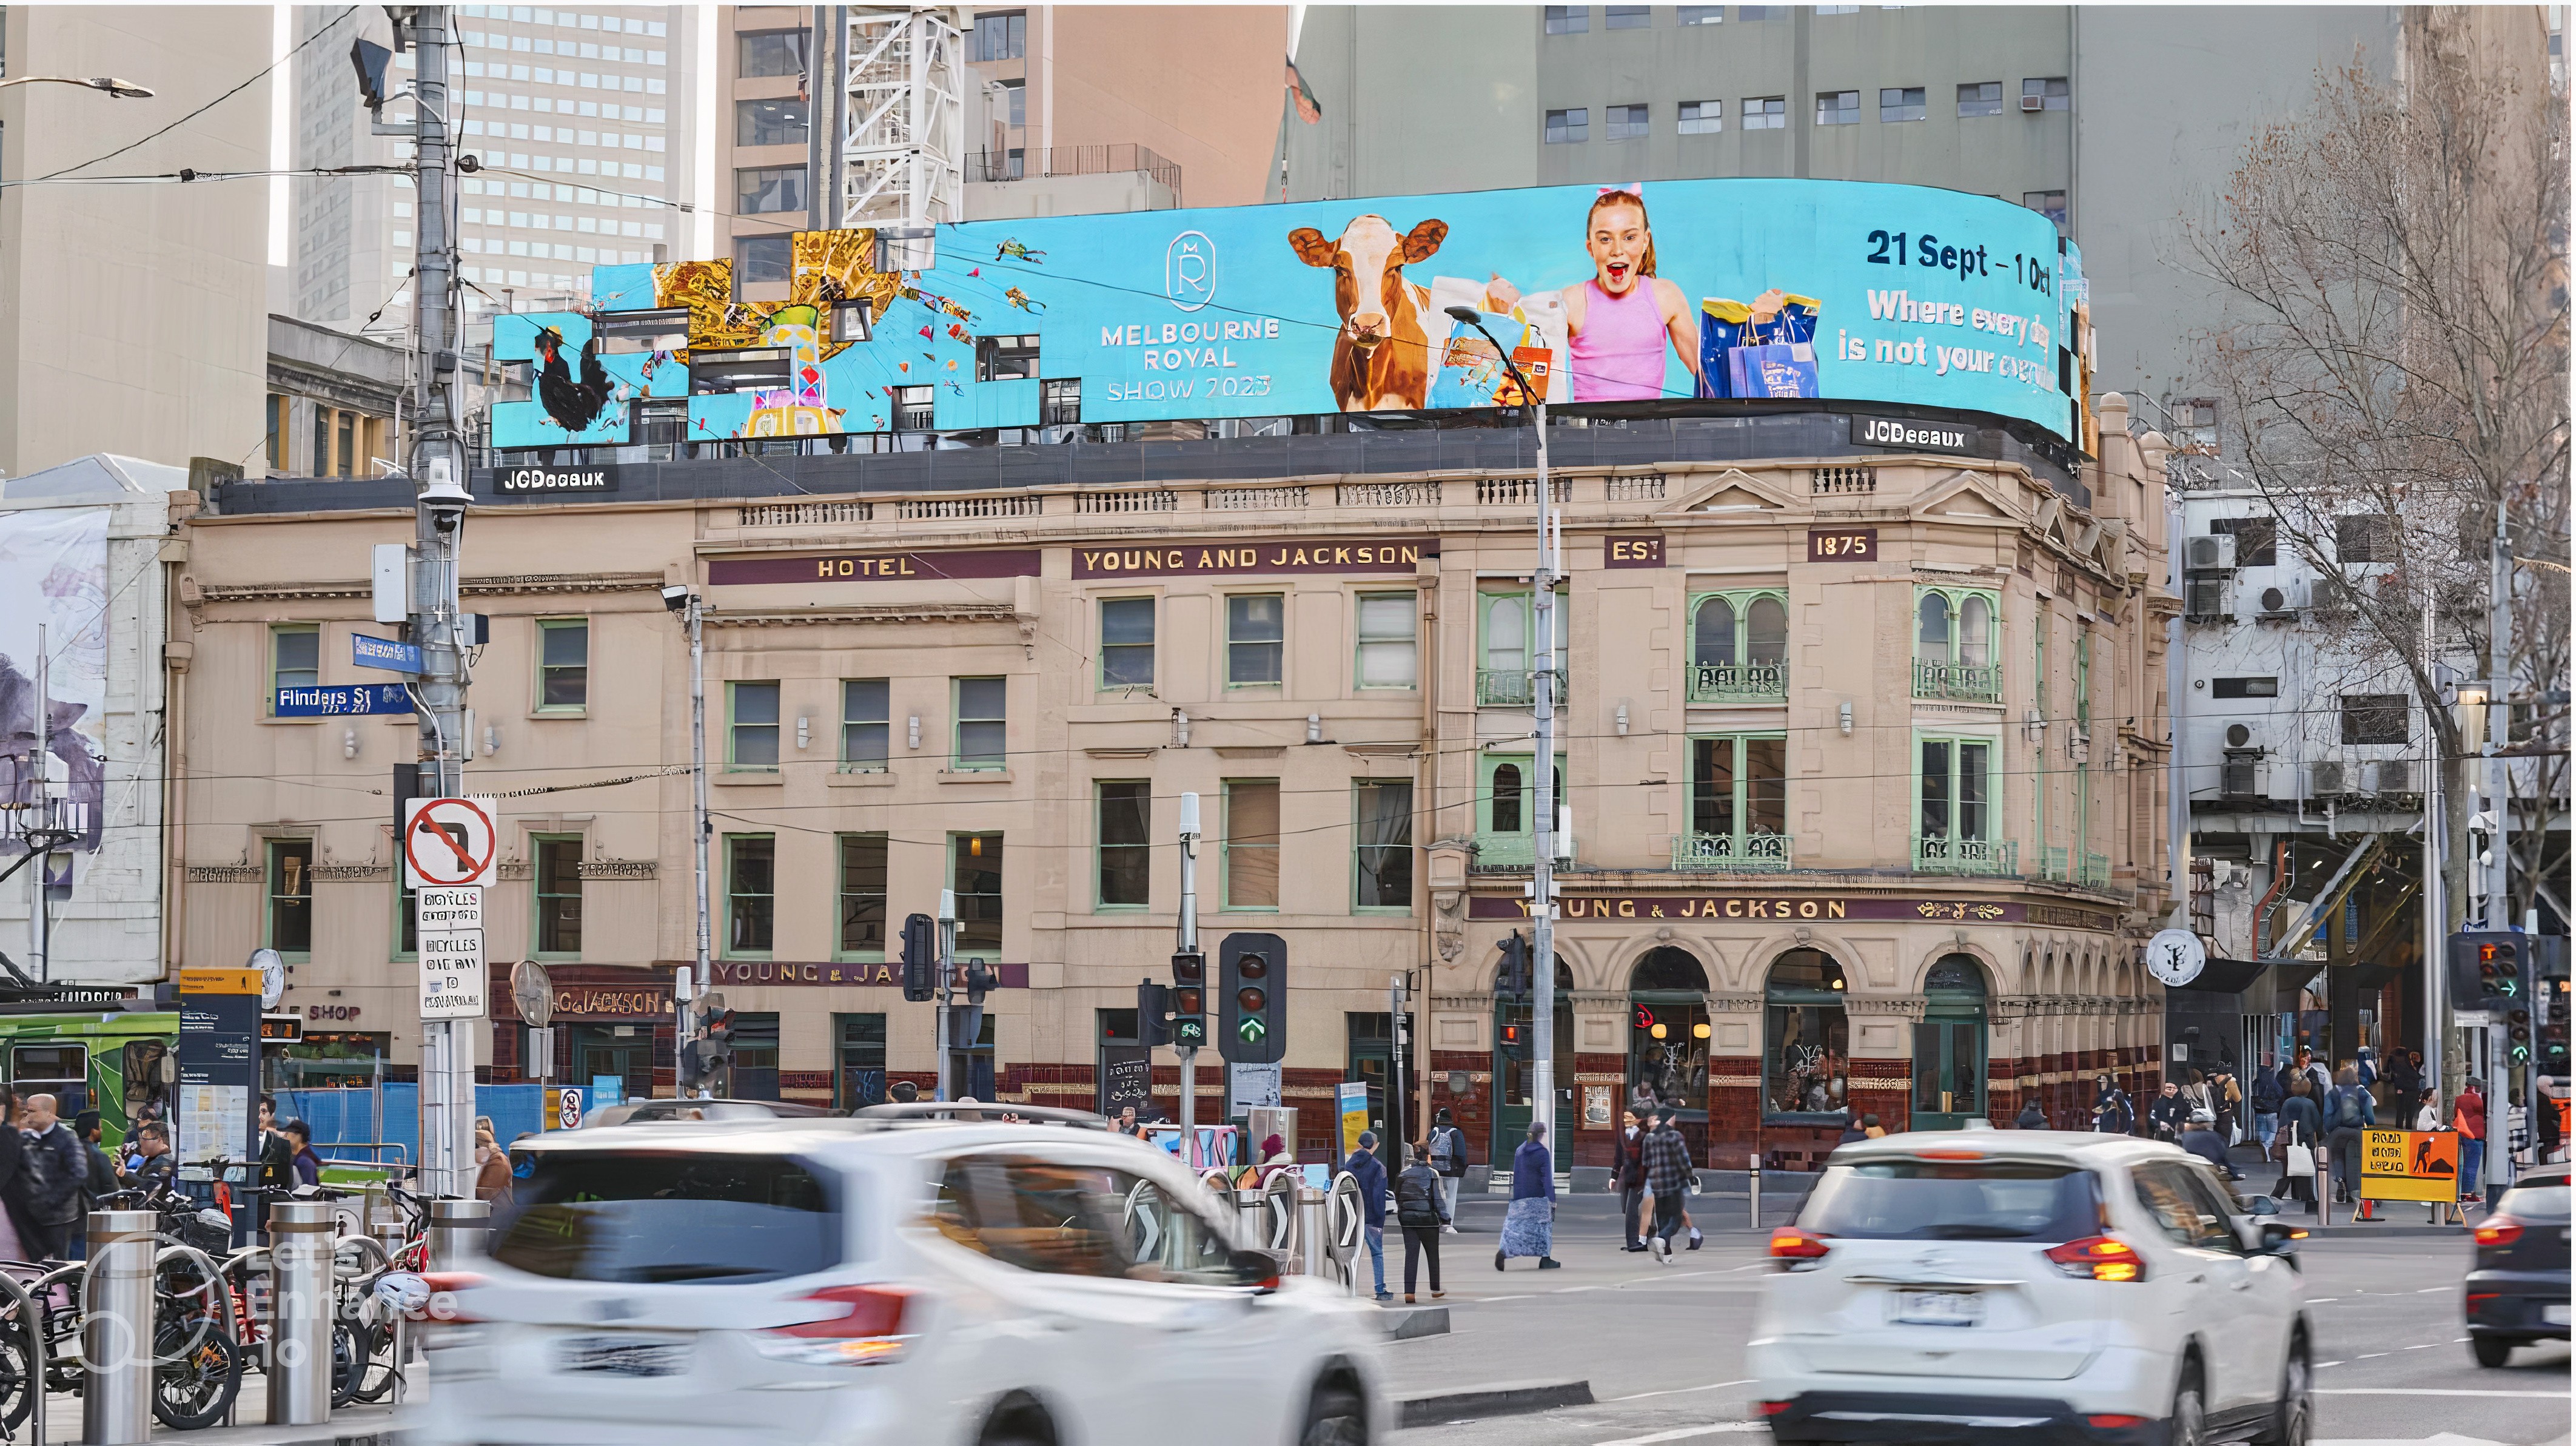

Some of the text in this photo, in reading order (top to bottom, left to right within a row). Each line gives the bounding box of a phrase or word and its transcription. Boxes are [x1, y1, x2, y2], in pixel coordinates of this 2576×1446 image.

[1867, 229, 1907, 266] 21
[1918, 234, 1988, 281] Sept
[2015, 253, 2022, 284] 1
[1867, 289, 1965, 327] Where
[1101, 318, 1280, 347] MELBOURNE
[1144, 346, 1238, 371] ROYAL
[1839, 329, 1867, 361] is
[1876, 336, 1928, 366] not
[1936, 345, 1995, 376] your
[1107, 378, 1195, 402] SHOW
[1817, 536, 1867, 556] 1875
[818, 557, 915, 577] HOTEL
[1083, 546, 1418, 571] YOUNG AND JACKSON
[280, 688, 346, 706] Flinders
[1515, 900, 1845, 918] YUNG & JACKSON
[309, 1004, 361, 1021] SHOP
